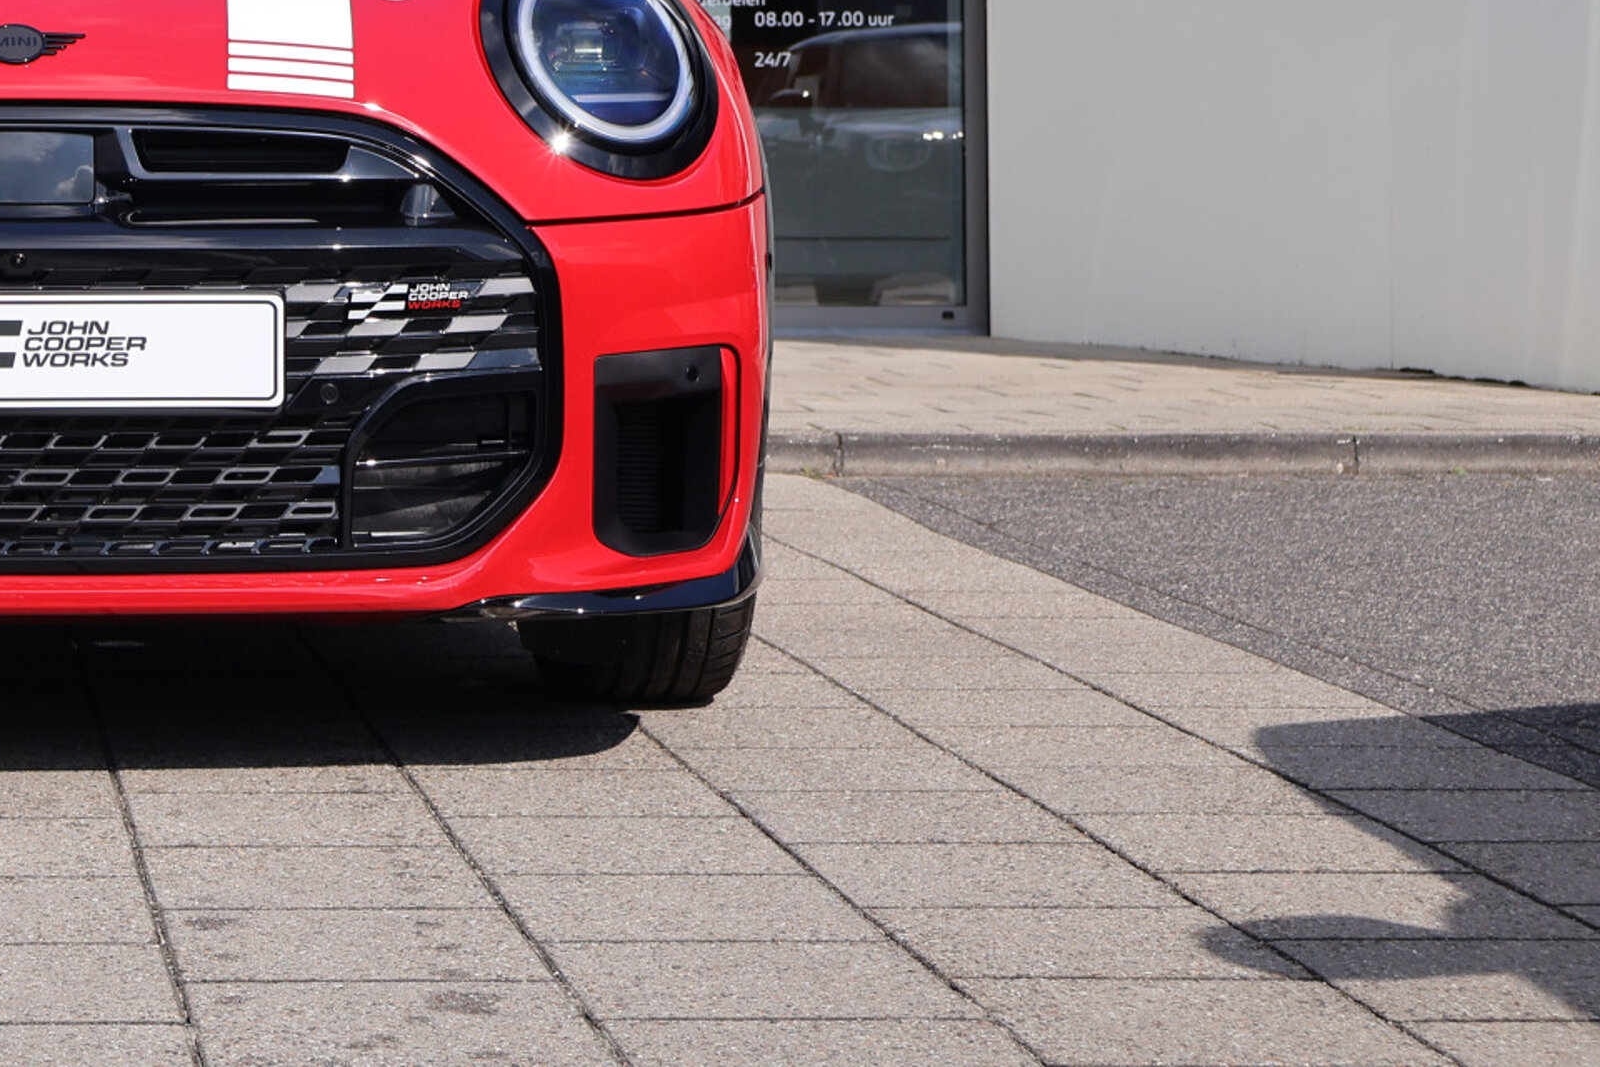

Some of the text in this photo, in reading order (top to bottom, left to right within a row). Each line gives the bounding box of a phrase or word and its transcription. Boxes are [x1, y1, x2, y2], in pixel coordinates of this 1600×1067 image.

[754, 11, 803, 28] 08.00
[868, 15, 895, 27] uur
[754, 51, 791, 68] 24/7
[410, 283, 450, 292] JOHN
[408, 291, 469, 300] COOPER
[408, 300, 461, 309] WORKS
[27, 320, 109, 335] JOHN
[24, 336, 147, 351] COOPER
[22, 352, 129, 367] WORKS
